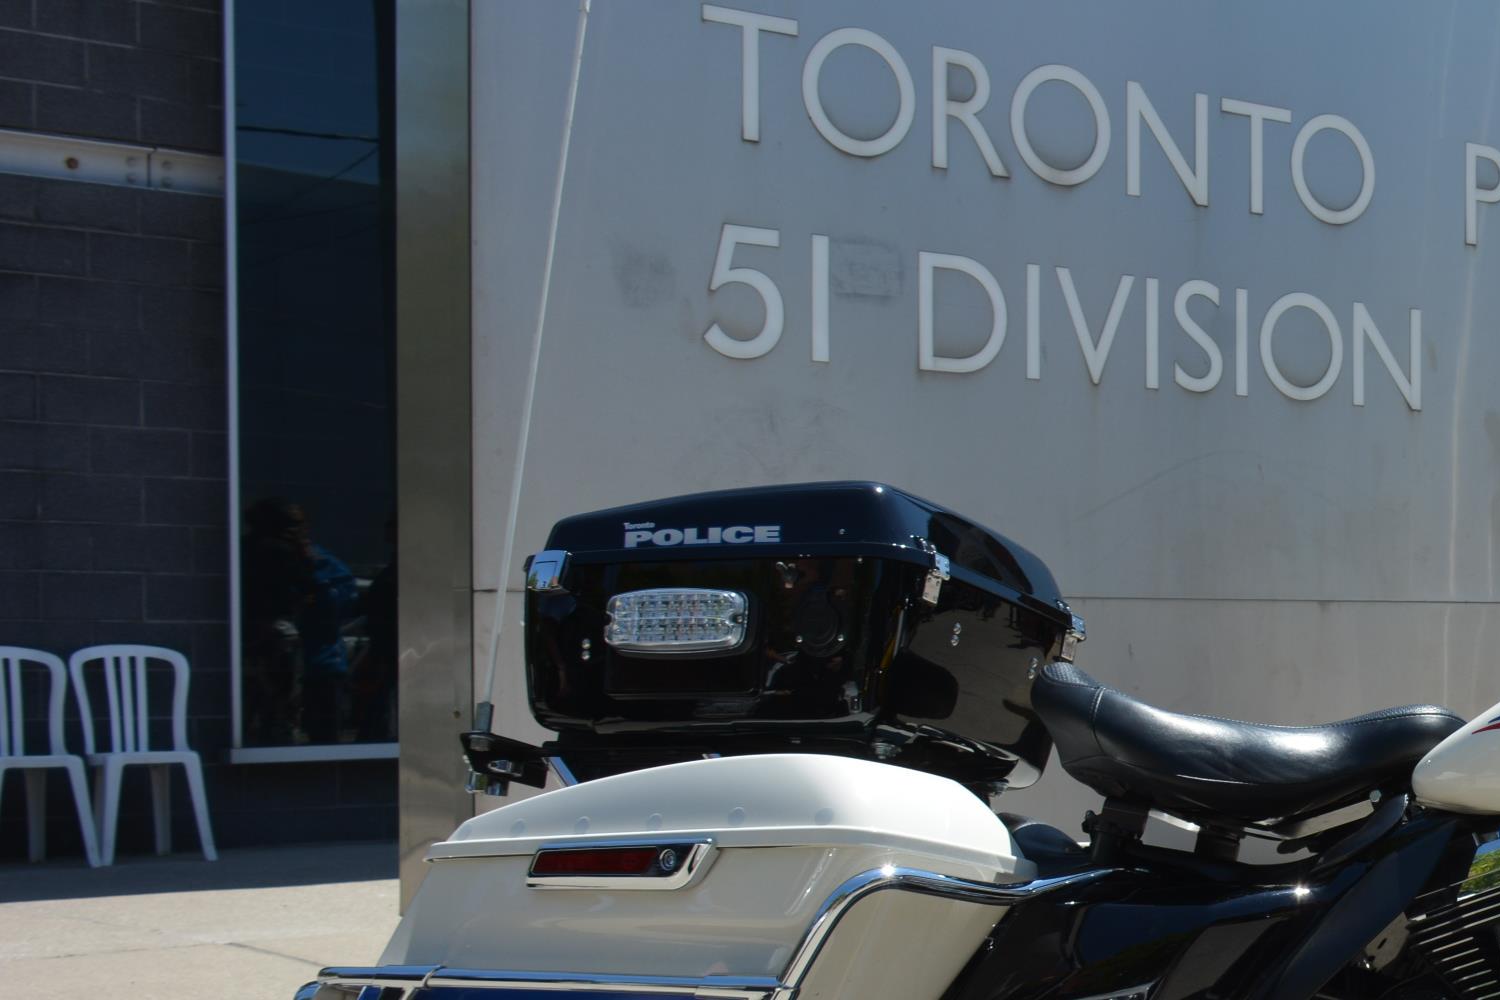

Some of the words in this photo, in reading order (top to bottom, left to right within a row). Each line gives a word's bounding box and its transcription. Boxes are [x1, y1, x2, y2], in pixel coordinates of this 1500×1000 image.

[702, 6, 1375, 225] TORONTO
[703, 223, 829, 363] 51
[918, 251, 1422, 412] DIVISION
[624, 525, 781, 548] POLICE
